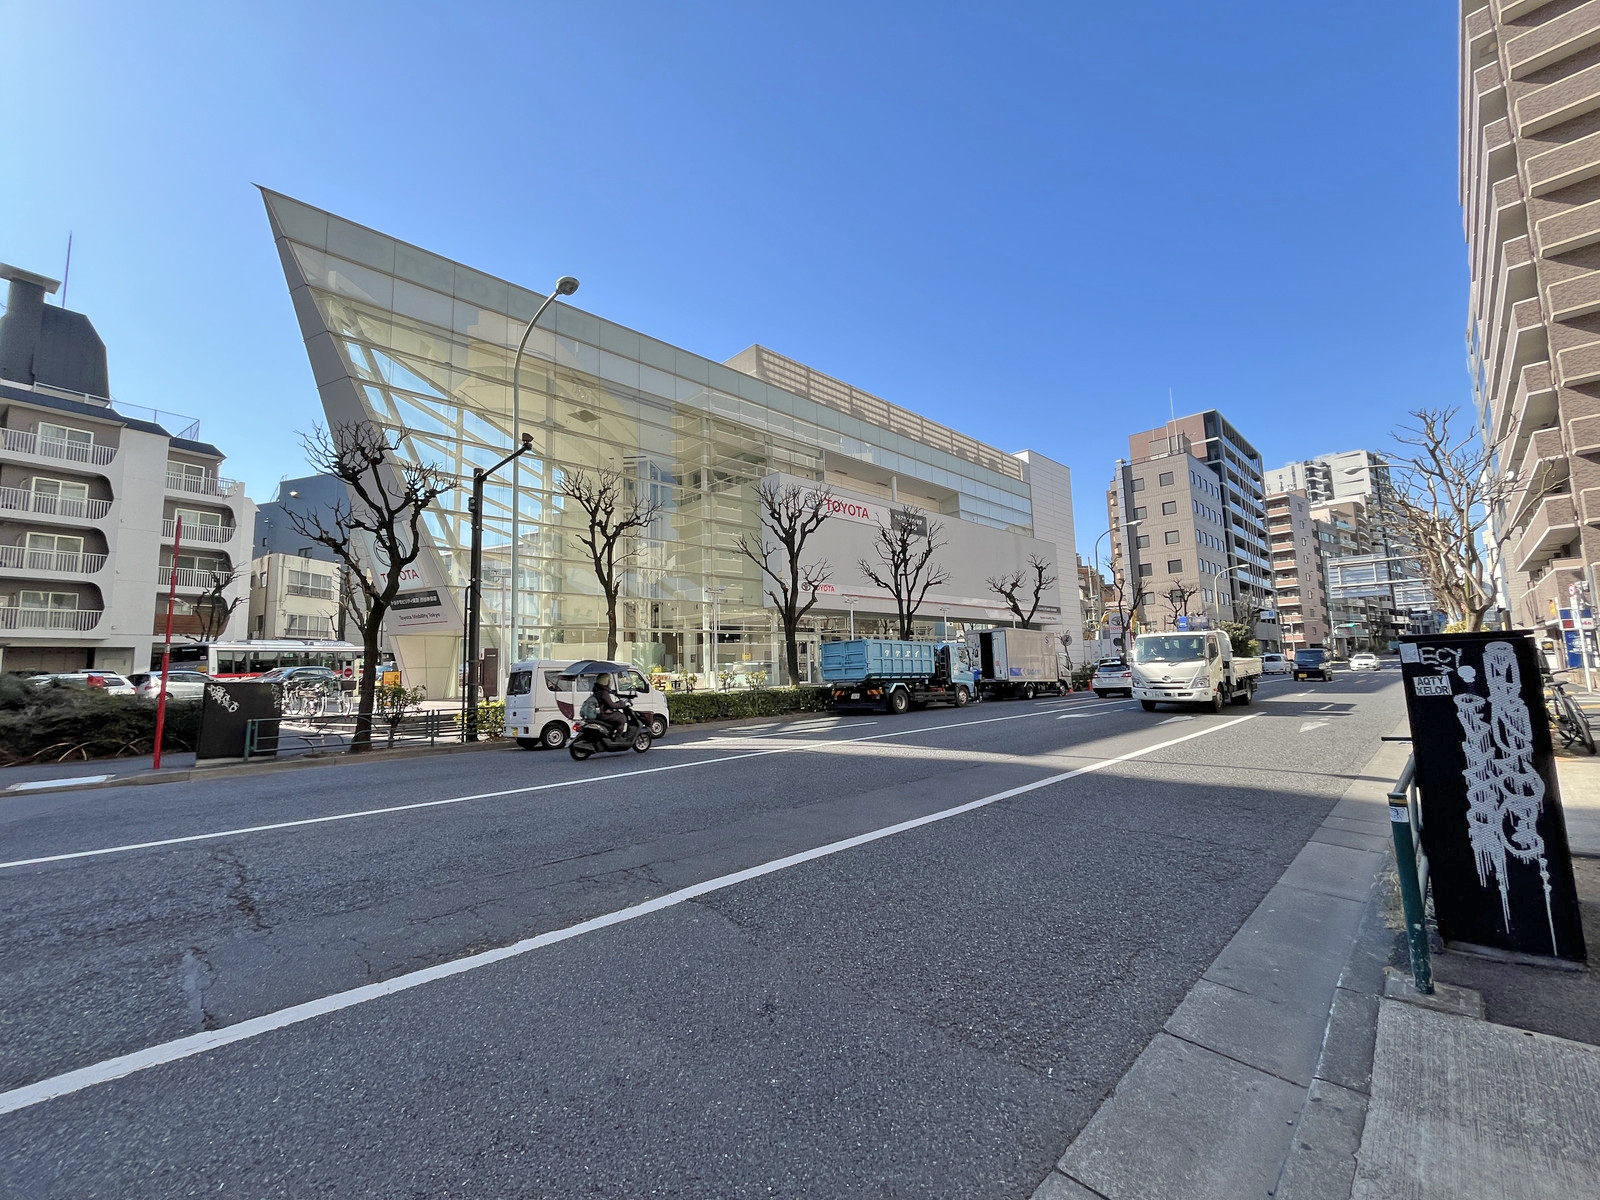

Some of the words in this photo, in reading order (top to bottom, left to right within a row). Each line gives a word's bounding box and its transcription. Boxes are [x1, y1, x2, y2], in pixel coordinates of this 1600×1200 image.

[824, 497, 869, 519] TOYOTA
[380, 569, 420, 583] TOTA
[1417, 677, 1443, 685] AQTY
